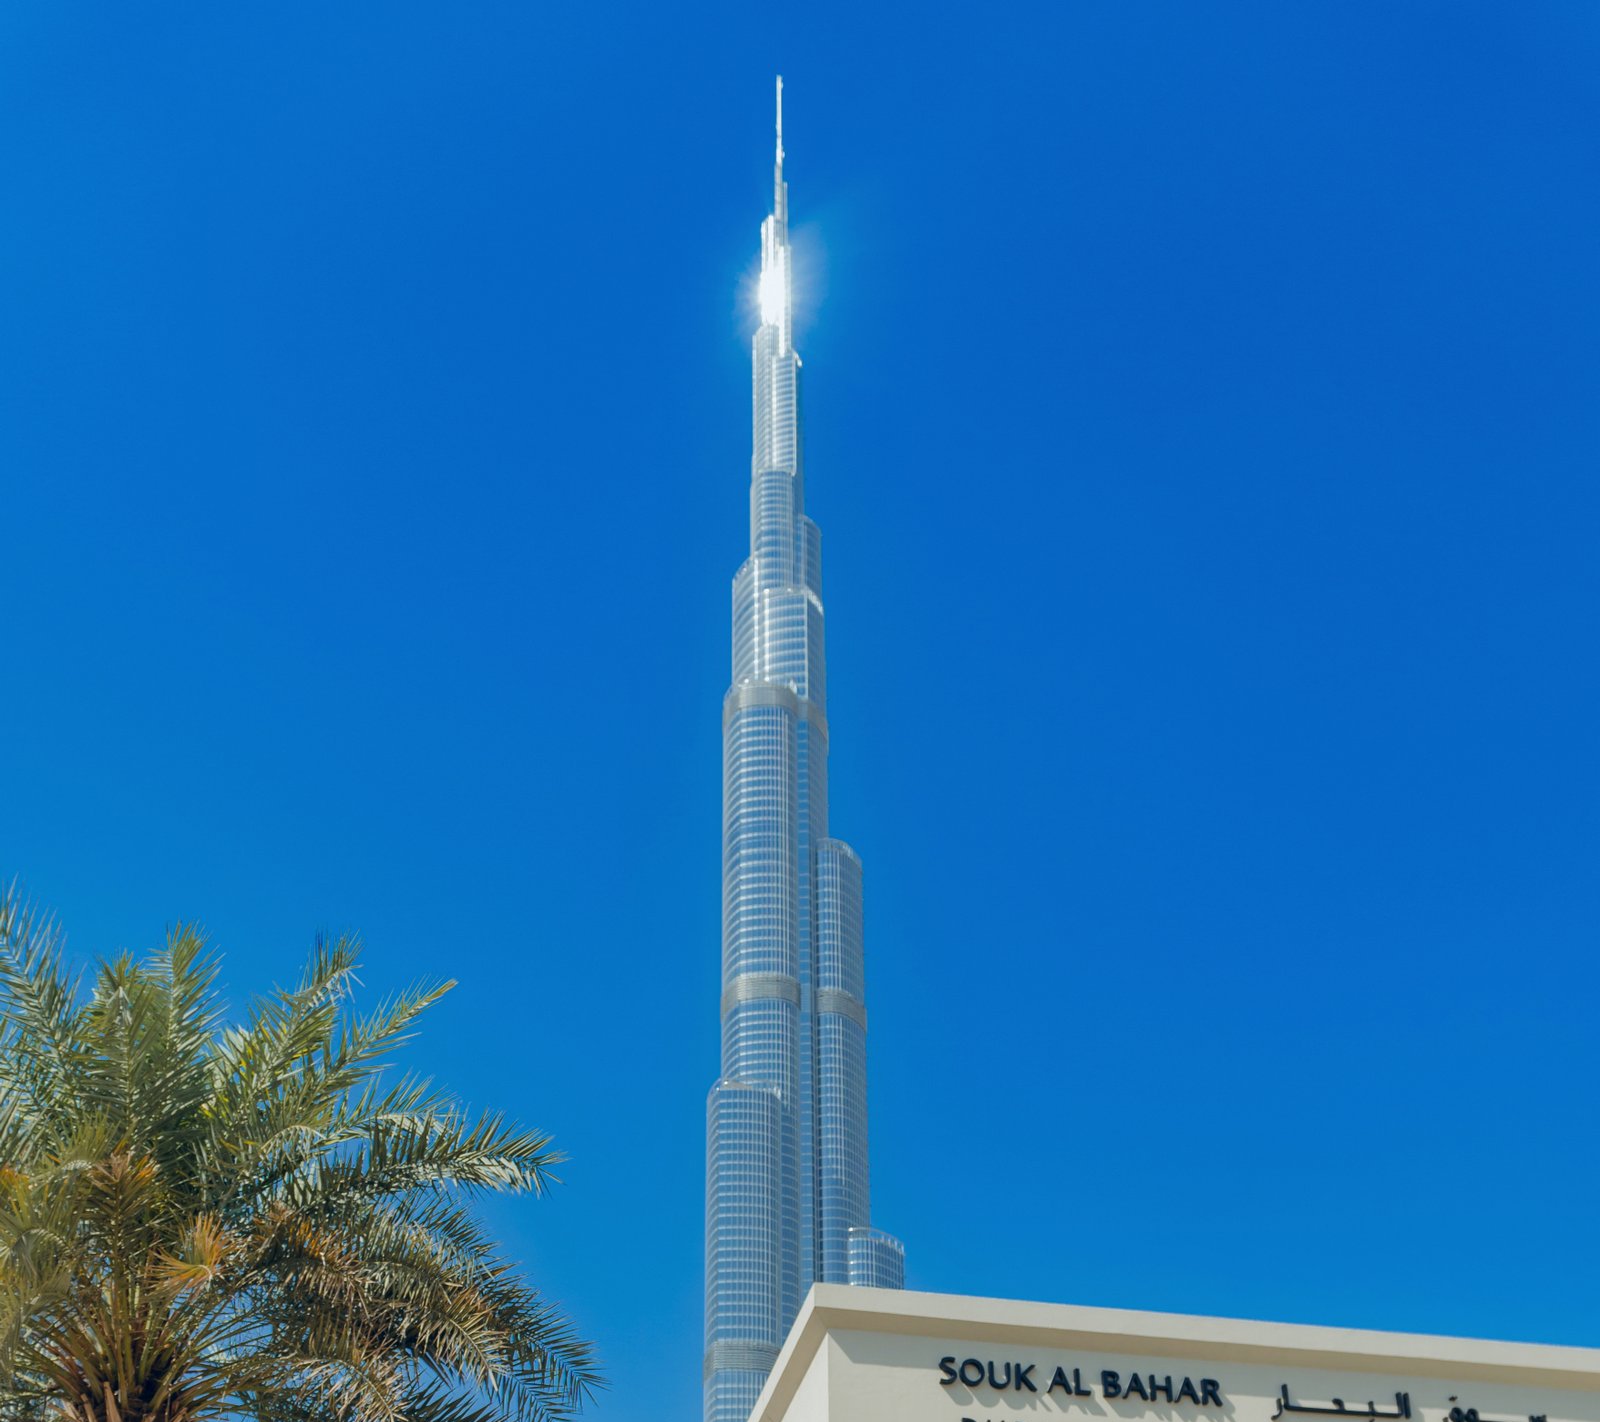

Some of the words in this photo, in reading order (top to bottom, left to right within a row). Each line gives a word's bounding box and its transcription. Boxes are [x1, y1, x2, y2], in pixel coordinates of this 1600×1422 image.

[939, 1356, 1037, 1392] SOUK
[1047, 1366, 1091, 1396] AL
[1101, 1370, 1223, 1407] BAHAR
